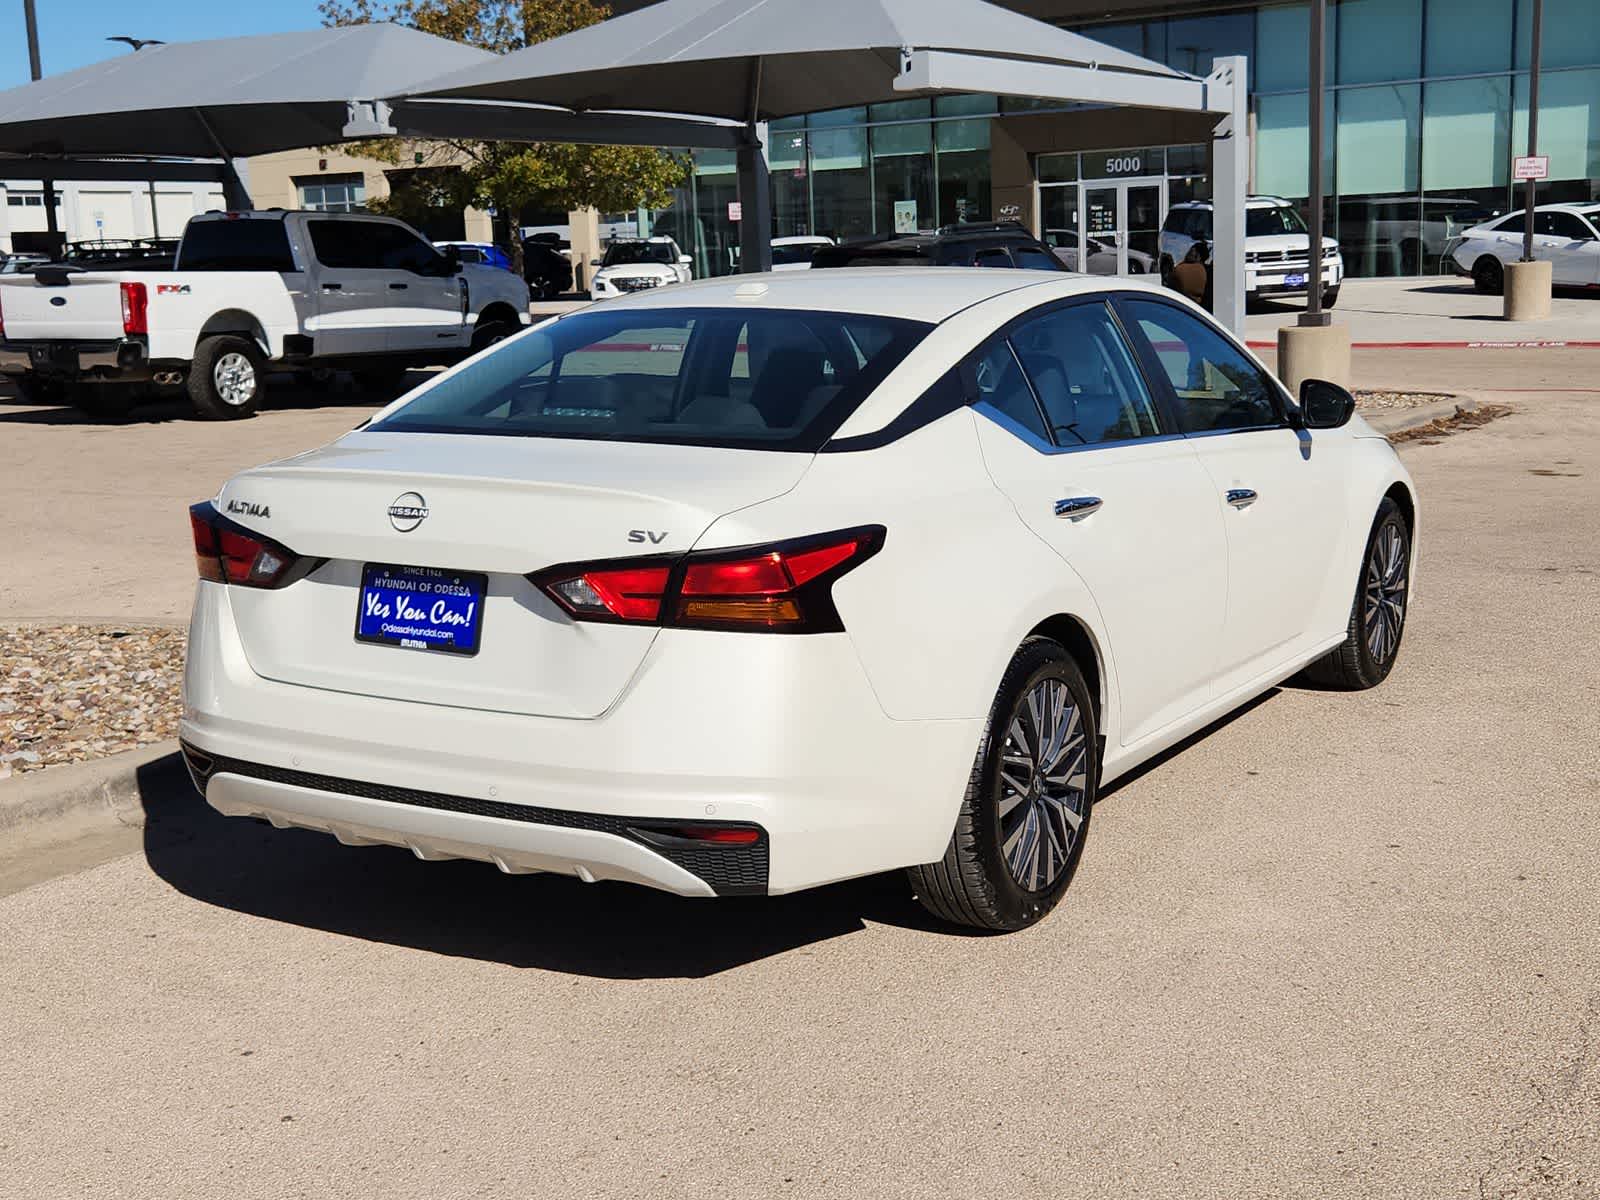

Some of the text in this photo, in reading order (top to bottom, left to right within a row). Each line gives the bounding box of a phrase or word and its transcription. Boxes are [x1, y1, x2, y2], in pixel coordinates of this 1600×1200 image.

[1105, 157, 1141, 173] 5000
[157, 284, 191, 296] FX4
[227, 499, 271, 519] ALTIMA
[387, 506, 429, 519] NISSAN
[627, 529, 669, 545] SV
[404, 566, 425, 577] SINCE
[374, 577, 472, 597] HYUNDAI OF ODESSA
[365, 592, 475, 628] Yes You Can!
[380, 622, 455, 640] OdessaHyundai.com
